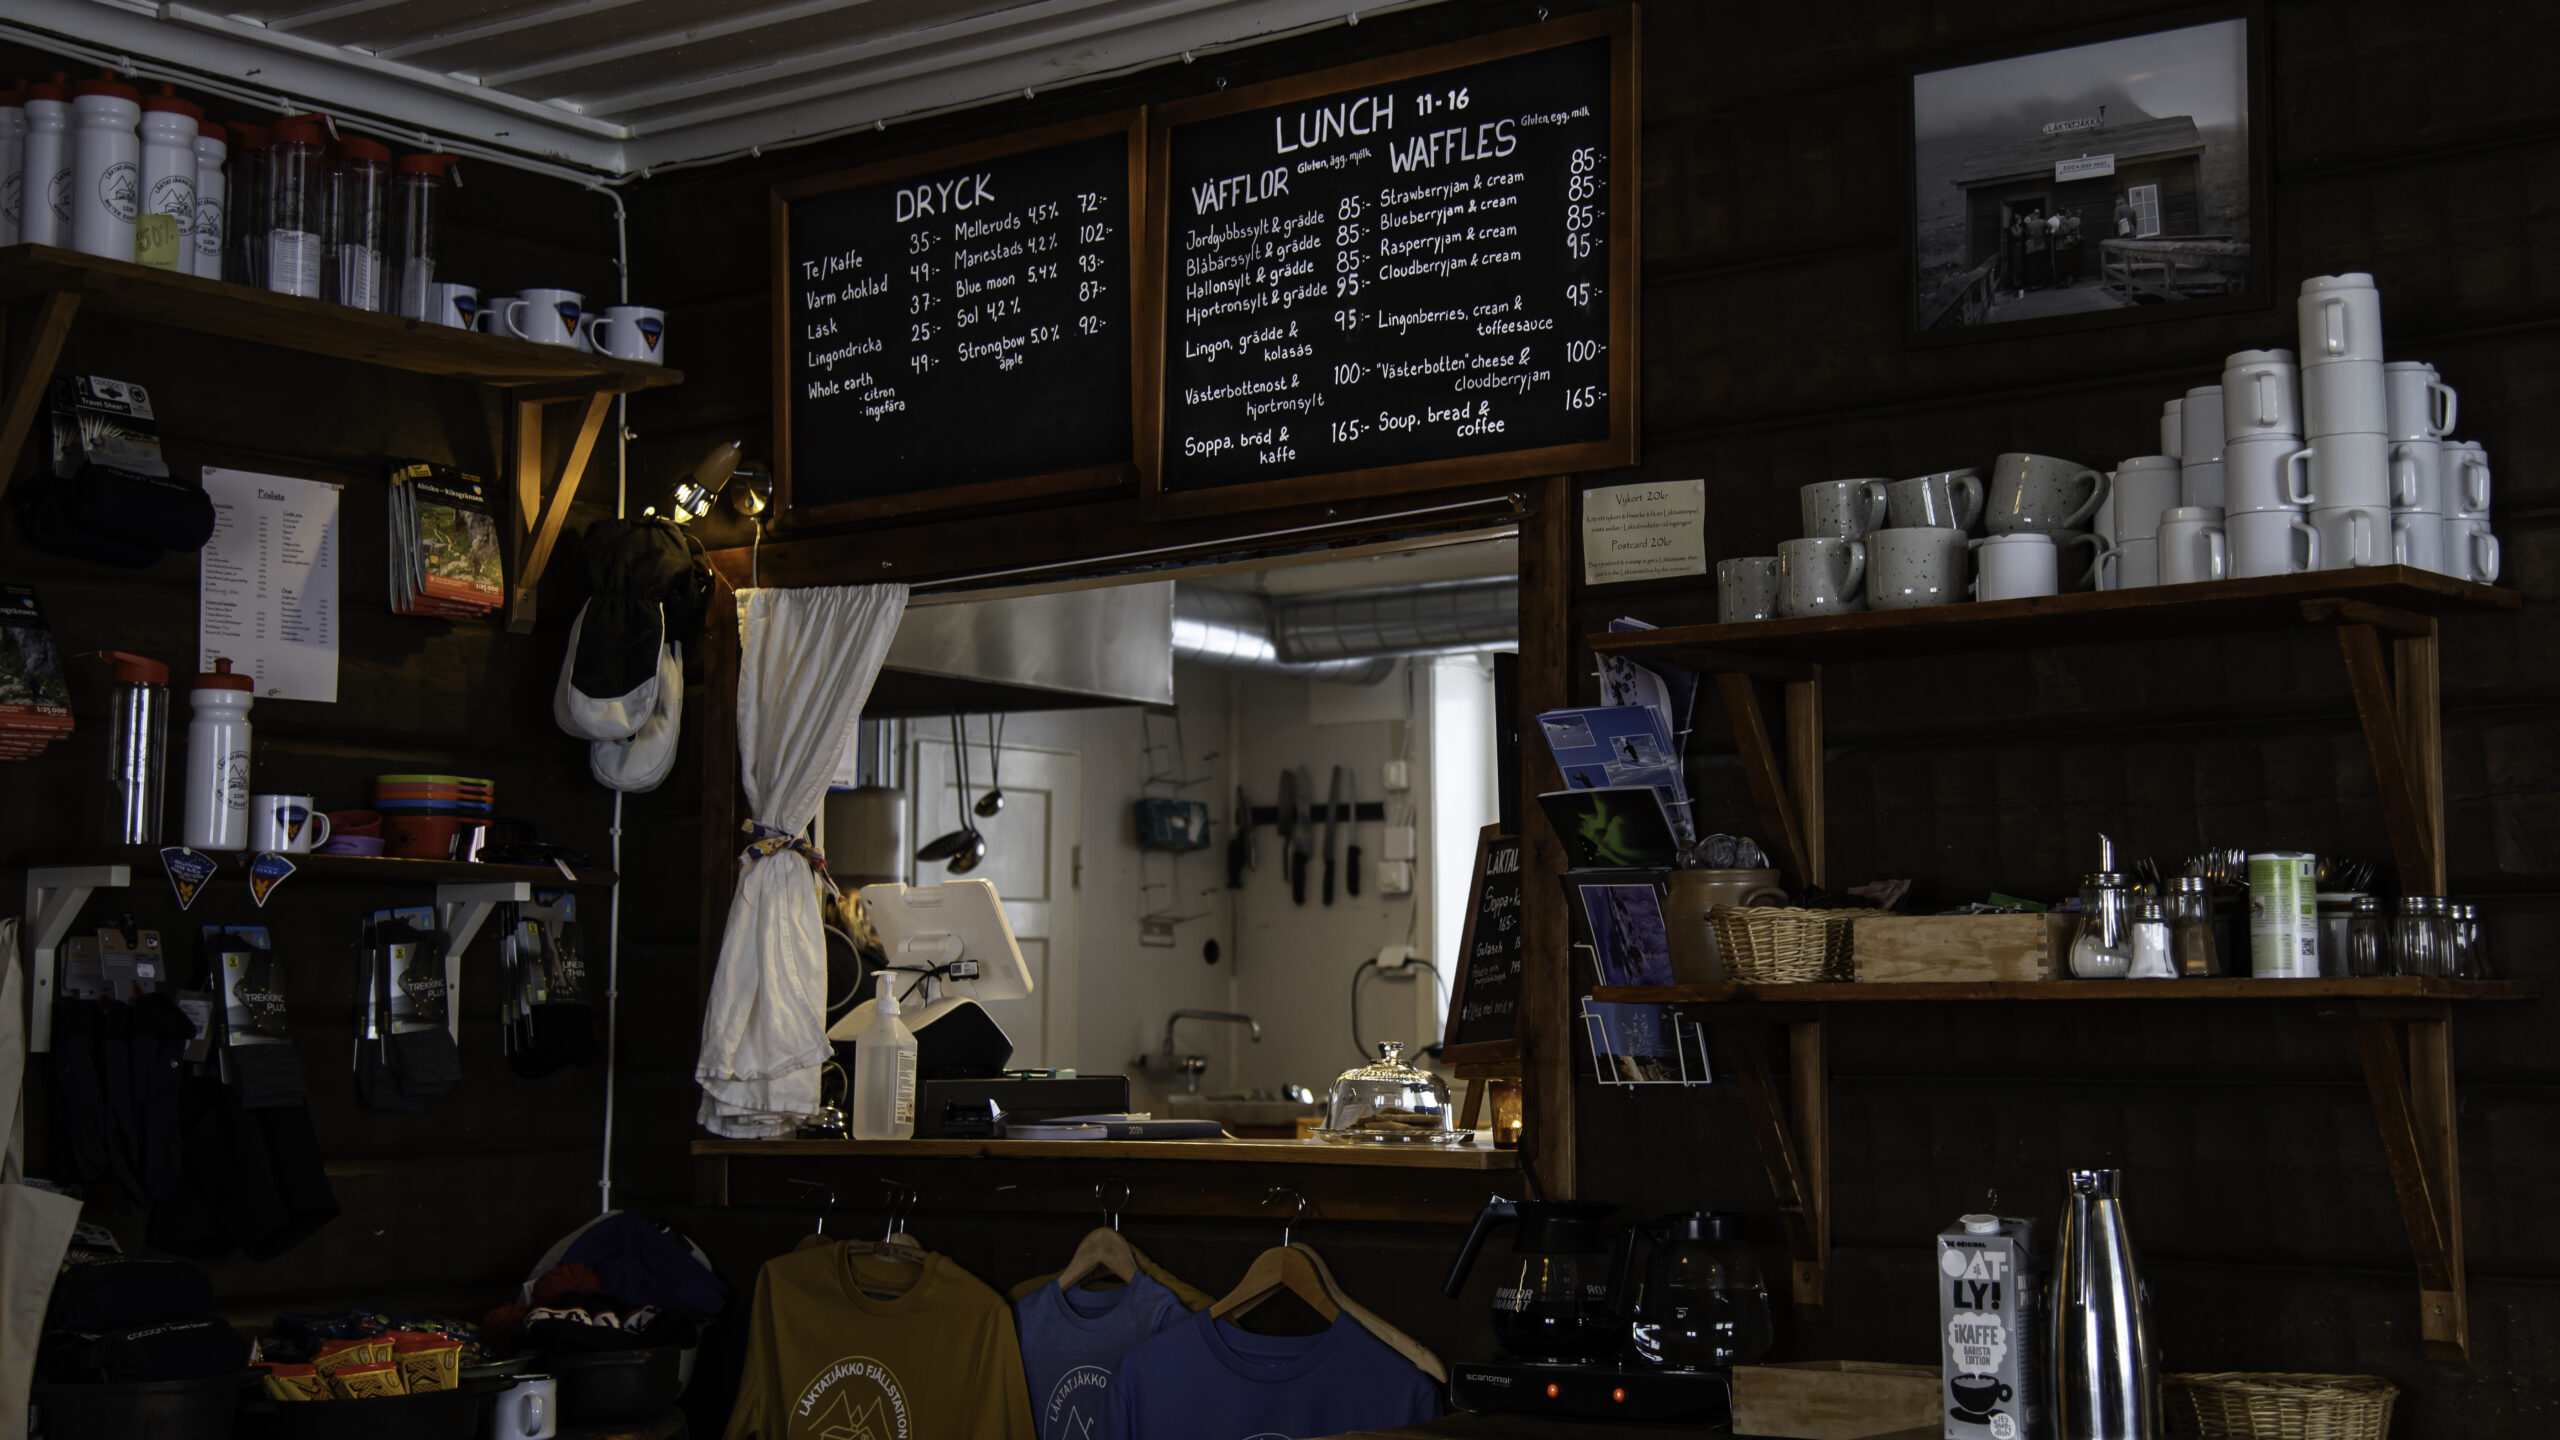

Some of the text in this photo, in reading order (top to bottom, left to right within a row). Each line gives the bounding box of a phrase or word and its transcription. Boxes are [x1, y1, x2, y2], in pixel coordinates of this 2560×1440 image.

[1276, 94, 1393, 154] LUNCH
[1389, 119, 1517, 173] WAFFLES
[1571, 106, 1590, 118] milk
[1297, 160, 1329, 174] Gluten,
[1380, 147, 1607, 207] Strawberryjam & cream 85:-
[896, 173, 995, 222] DRYCK
[955, 212, 1021, 241] Melleruds
[1077, 193, 1107, 213] 72:-
[1380, 176, 1607, 231] Blueberryjam & cream 85:-
[1186, 195, 1371, 252] Jordgubbssylt & grädde 85:-
[1466, 226, 1476, 241] &
[1479, 224, 1517, 240] cream
[1566, 204, 1606, 231] 85:-
[803, 232, 941, 280] Te/Kaffe 35:-
[954, 243, 1024, 270] Mariestads
[1079, 223, 1113, 244] 102:-
[1186, 224, 1370, 277] Blåbärssylt & grädde 85:-
[1379, 232, 1603, 281] Cloudberryjam & cream 95:-
[807, 263, 940, 310] Varm choklad 49:-
[956, 279, 982, 299] Blue
[986, 273, 1015, 291] moon
[1079, 254, 1104, 273] 93:-
[1186, 250, 1371, 300] Hallonsylt & grädde 85:-
[808, 294, 941, 340] Läsk 37:-
[957, 308, 978, 328] Sol
[1079, 281, 1106, 302] 87:-
[1186, 273, 1371, 326] Hjortronsylt & grädde 95:-
[1378, 282, 1603, 336] Lingonberries, cream & 95:-
[808, 322, 941, 371] Lingondricka 25:-
[958, 334, 1025, 362] Strongbow
[1079, 315, 1106, 335] 92:-
[1186, 309, 1370, 362] Lingon, grädde & 95:-
[1477, 318, 1554, 336] toffeesauce
[999, 353, 1023, 371] äpple
[1264, 343, 1313, 362] kolasås
[1471, 354, 1515, 369] cheese
[1518, 346, 1531, 366] &
[1566, 339, 1607, 363] 100:-
[808, 355, 939, 399] Whole earth 49:-
[1185, 362, 1371, 405] Västerbottenost & 100:-
[1454, 367, 1551, 395] cloudberryjam
[81, 398, 102, 408] Travel
[1246, 392, 1325, 421] hjortronsylt
[1428, 401, 1470, 423] bread
[1478, 400, 1491, 416] &
[1565, 385, 1608, 411] 165:-
[1185, 419, 1370, 458] Soppa, bröd & 165:-
[1457, 417, 1505, 437] coffee
[1260, 446, 1296, 464] kaffe
[417, 482, 484, 502] Abisko Riksgränsen
[1615, 490, 1669, 507] Vykort 20kr
[1611, 537, 1672, 552] Postcard 20kr
[562, 961, 584, 969] LINER
[1476, 941, 1503, 957] Gulasch
[568, 969, 586, 977] THIN
[266, 1003, 287, 1012] PLUS
[1942, 1249, 2009, 1281] OAT-
[1953, 1280, 2001, 1310] LY!
[1954, 1324, 1999, 1345] iKAFFE
[1964, 1346, 1991, 1356] BARISTA
[1465, 1373, 1510, 1385] scanomat
[1965, 1356, 1991, 1366] EDITION
[799, 1362, 908, 1439] LÅKTATJÅKKO FJÄLLSTATION
[1049, 1370, 1107, 1423] LÅKTATJÅKKO
